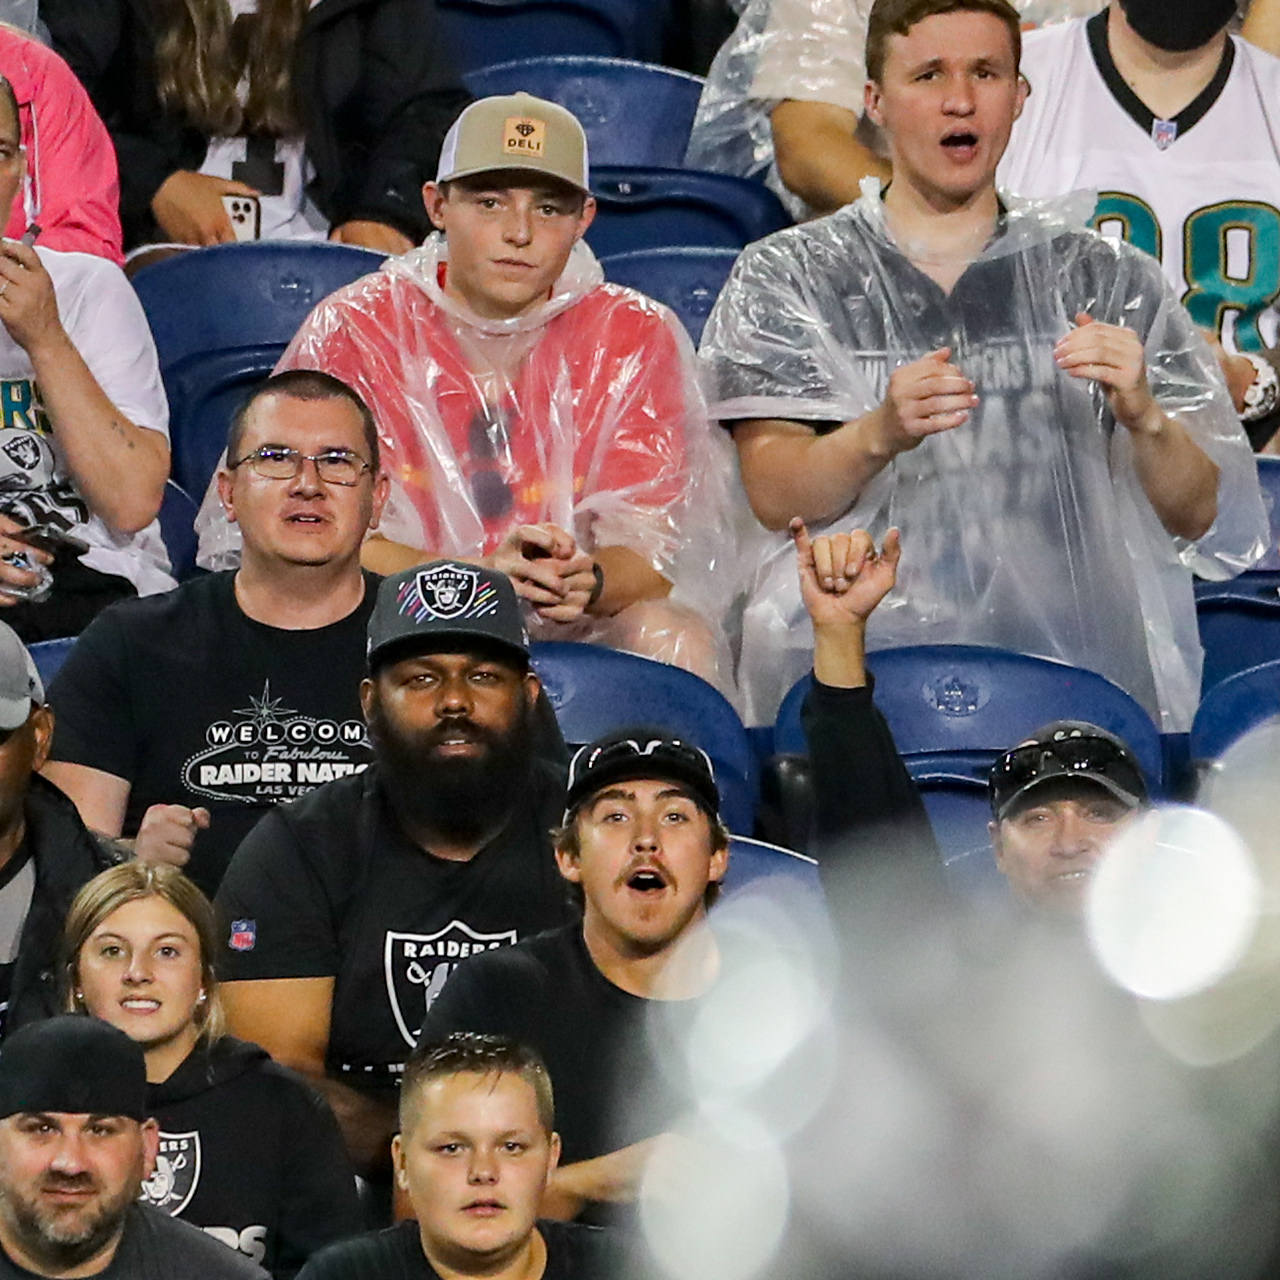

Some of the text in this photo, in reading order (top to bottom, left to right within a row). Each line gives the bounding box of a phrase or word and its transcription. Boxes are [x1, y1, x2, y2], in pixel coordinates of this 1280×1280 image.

[507, 138, 541, 151] DELI
[424, 572, 469, 581] RAIDERS
[211, 723, 362, 744] WELCOM
[244, 745, 350, 762] TO Fabulous
[200, 762, 293, 786] RAIDER
[256, 785, 283, 795] LAS
